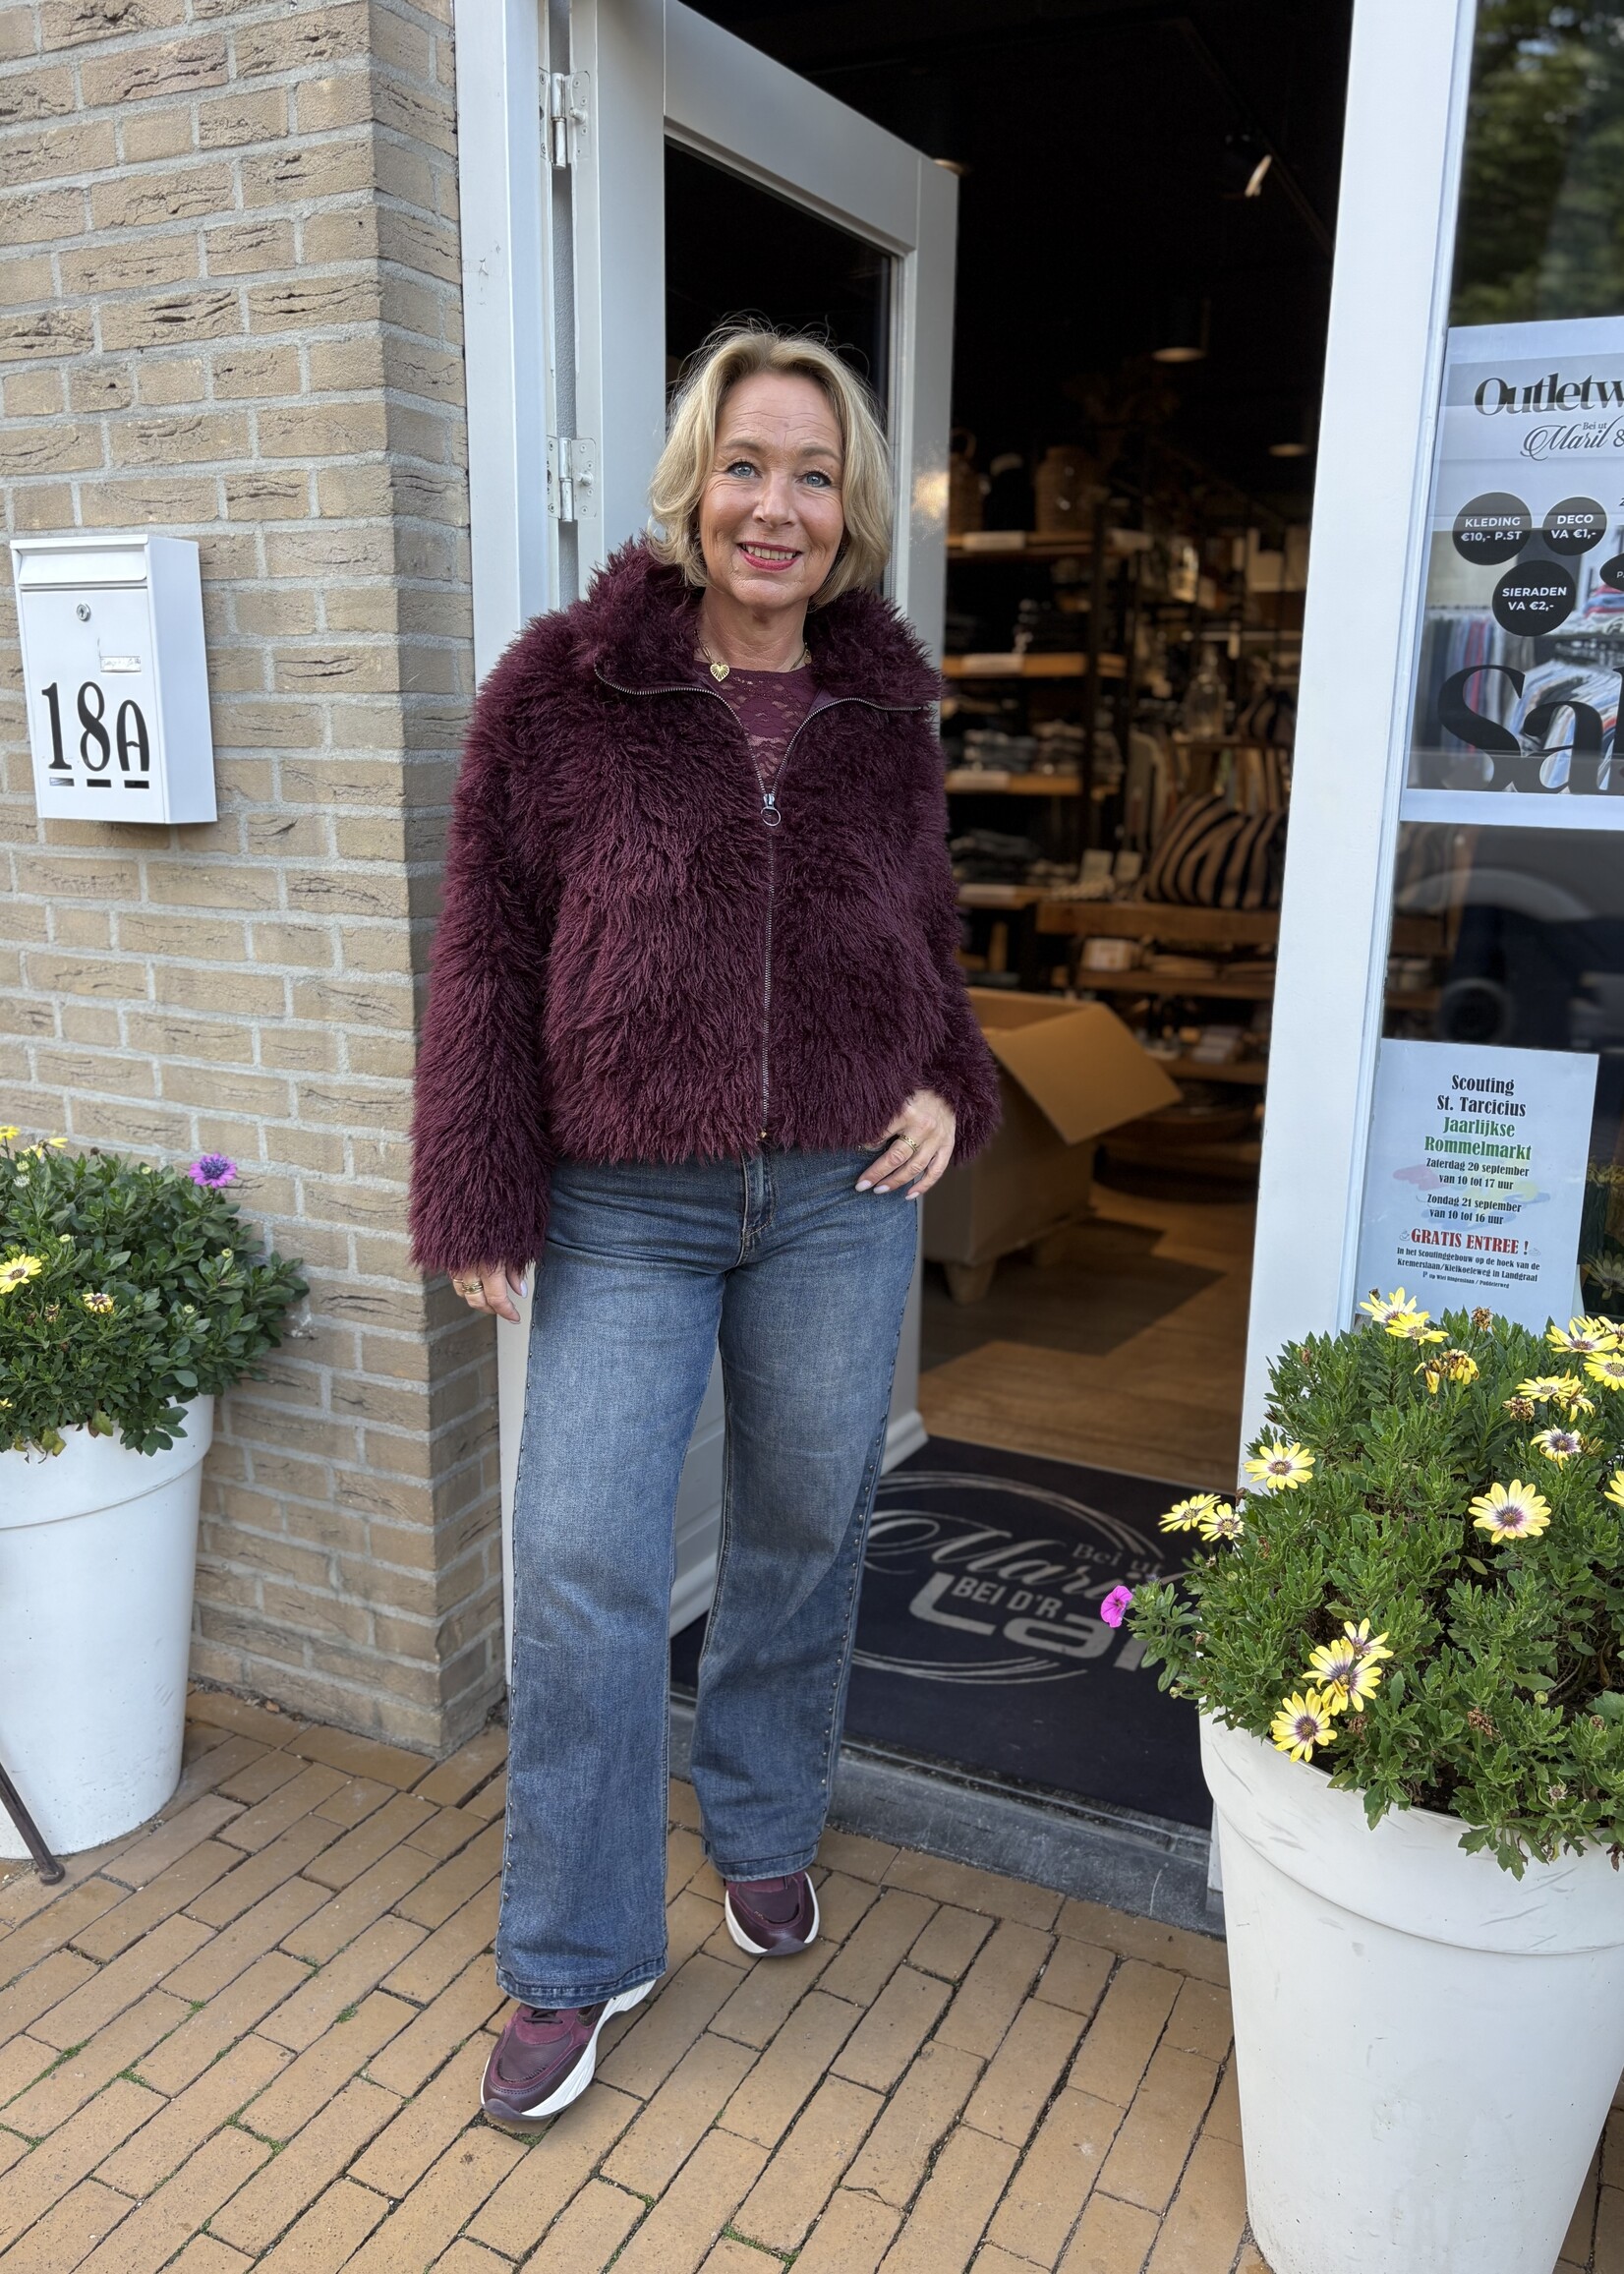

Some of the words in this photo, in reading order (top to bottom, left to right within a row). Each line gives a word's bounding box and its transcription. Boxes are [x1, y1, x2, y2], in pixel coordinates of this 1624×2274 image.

[1520, 415, 1624, 461] Maril
[1465, 516, 1521, 528] KLEDING
[1556, 514, 1594, 525] DECO
[1461, 532, 1491, 543] €10,-
[1494, 530, 1522, 542] P.ST
[1550, 529, 1569, 539] VA
[1573, 528, 1596, 540] €1,-
[1501, 587, 1567, 598] SIERADEN
[1507, 602, 1526, 611] VA
[1529, 601, 1554, 612] €2,-
[41, 681, 149, 772] 18A
[1451, 1075, 1515, 1096] Scouting
[1436, 1095, 1454, 1111] St.
[1460, 1096, 1527, 1117] Tarcicius
[1442, 1117, 1515, 1137] Jaarlijkse
[1424, 1136, 1532, 1160] Rommelmarkt
[1426, 1157, 1466, 1172] Zaterdag
[1467, 1162, 1479, 1172] 20
[1481, 1164, 1530, 1177] september
[1439, 1174, 1455, 1184] van
[1457, 1175, 1468, 1185] 10
[1470, 1177, 1482, 1187] tot
[1484, 1178, 1495, 1188] 17
[1497, 1180, 1514, 1190] uur
[1426, 1194, 1460, 1206] Zondag
[1461, 1197, 1472, 1207] 21
[1475, 1199, 1522, 1212] september
[1429, 1208, 1446, 1218] van
[1448, 1209, 1458, 1219] 10
[1461, 1211, 1473, 1221] tot
[1476, 1213, 1485, 1222] 16
[1487, 1215, 1504, 1225] uur
[1411, 1228, 1462, 1248] GRATIS
[1466, 1234, 1519, 1254] ENTREE
[1405, 1248, 1417, 1256] het
[1475, 1256, 1484, 1265] op
[1496, 1258, 1514, 1268] hoek
[1516, 1261, 1530, 1270] van
[1531, 1262, 1540, 1271] de
[1501, 1270, 1537, 1282] Landgraaf
[1072, 1543, 1122, 1566] Bei
[952, 1577, 1001, 1605] BEI
[1007, 1590, 1063, 1618] D'R
